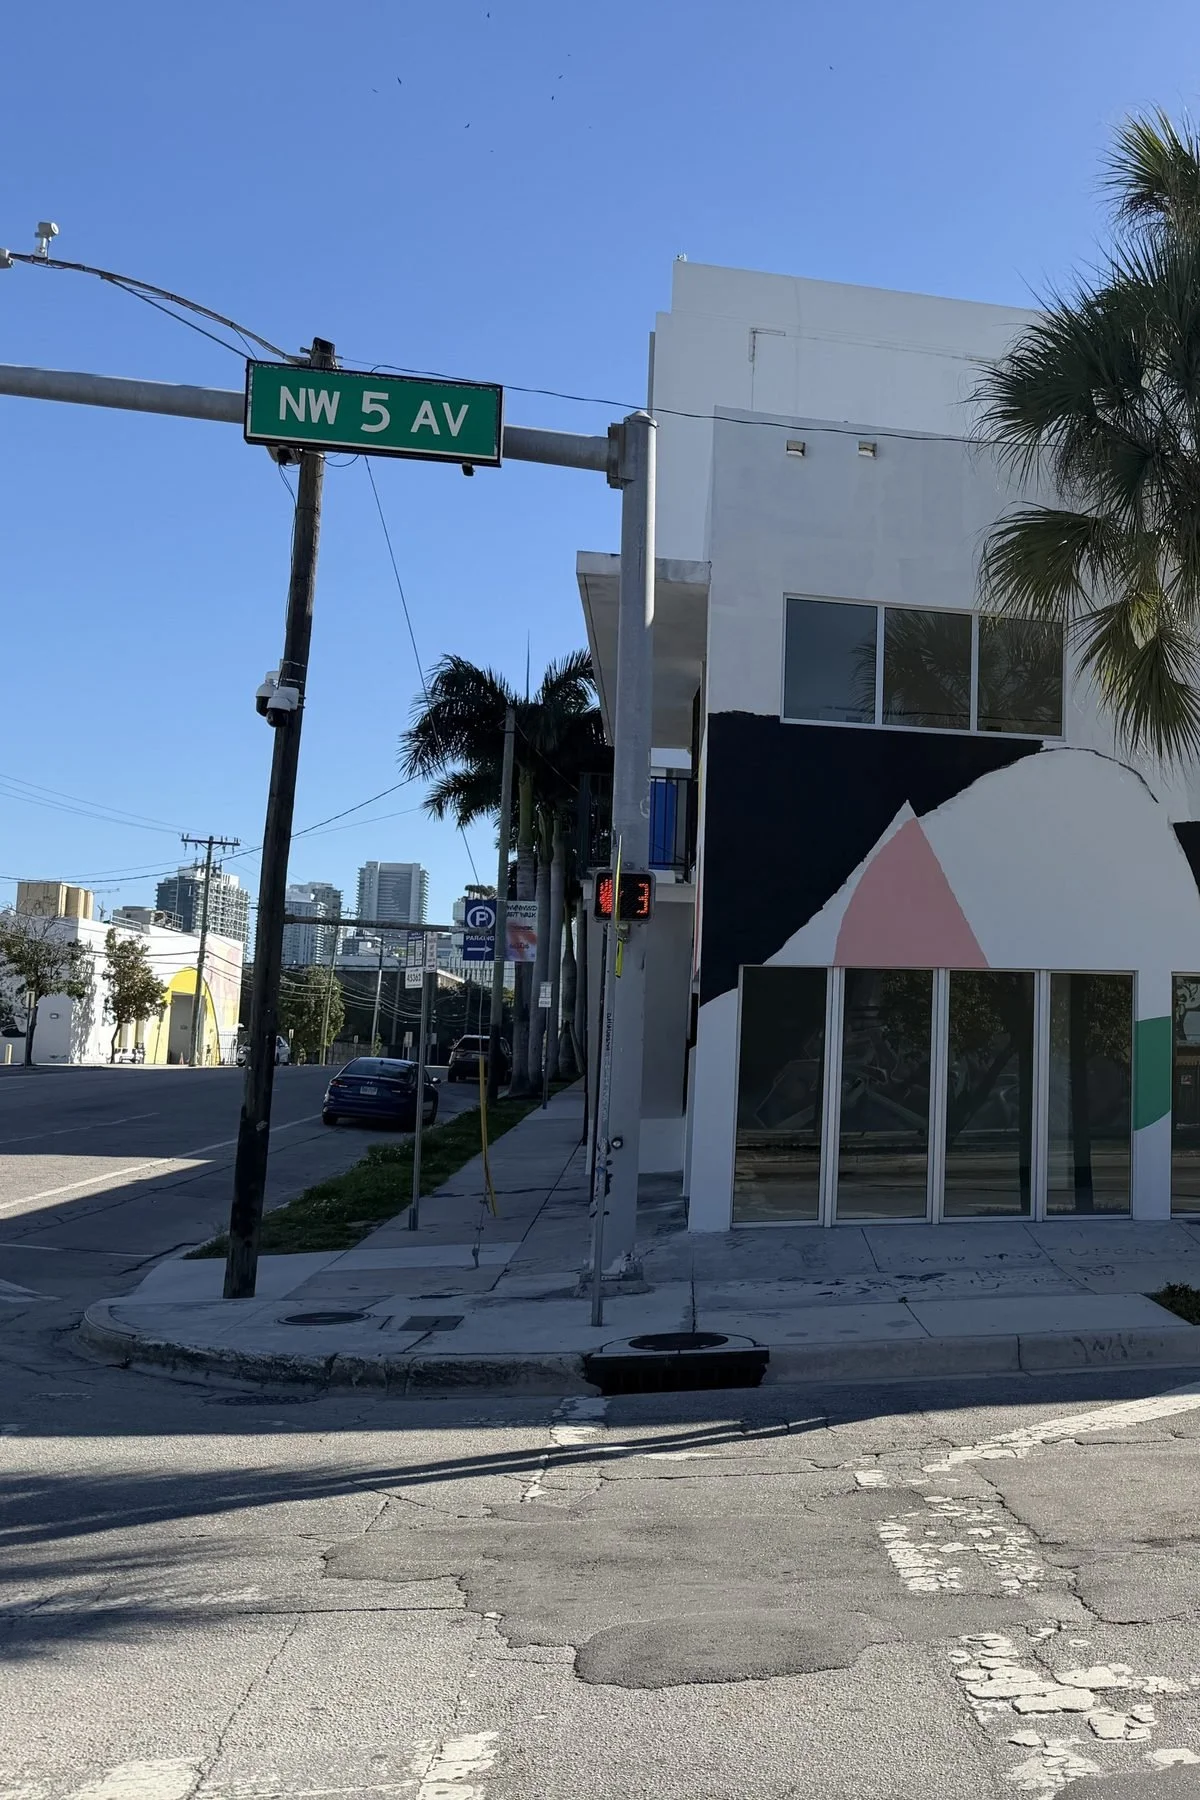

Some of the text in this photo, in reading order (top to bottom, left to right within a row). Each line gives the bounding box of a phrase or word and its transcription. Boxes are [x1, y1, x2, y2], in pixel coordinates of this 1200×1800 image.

[279, 385, 469, 437] NW 5 AV
[636, 883, 649, 914] 3
[476, 911, 488, 926] P
